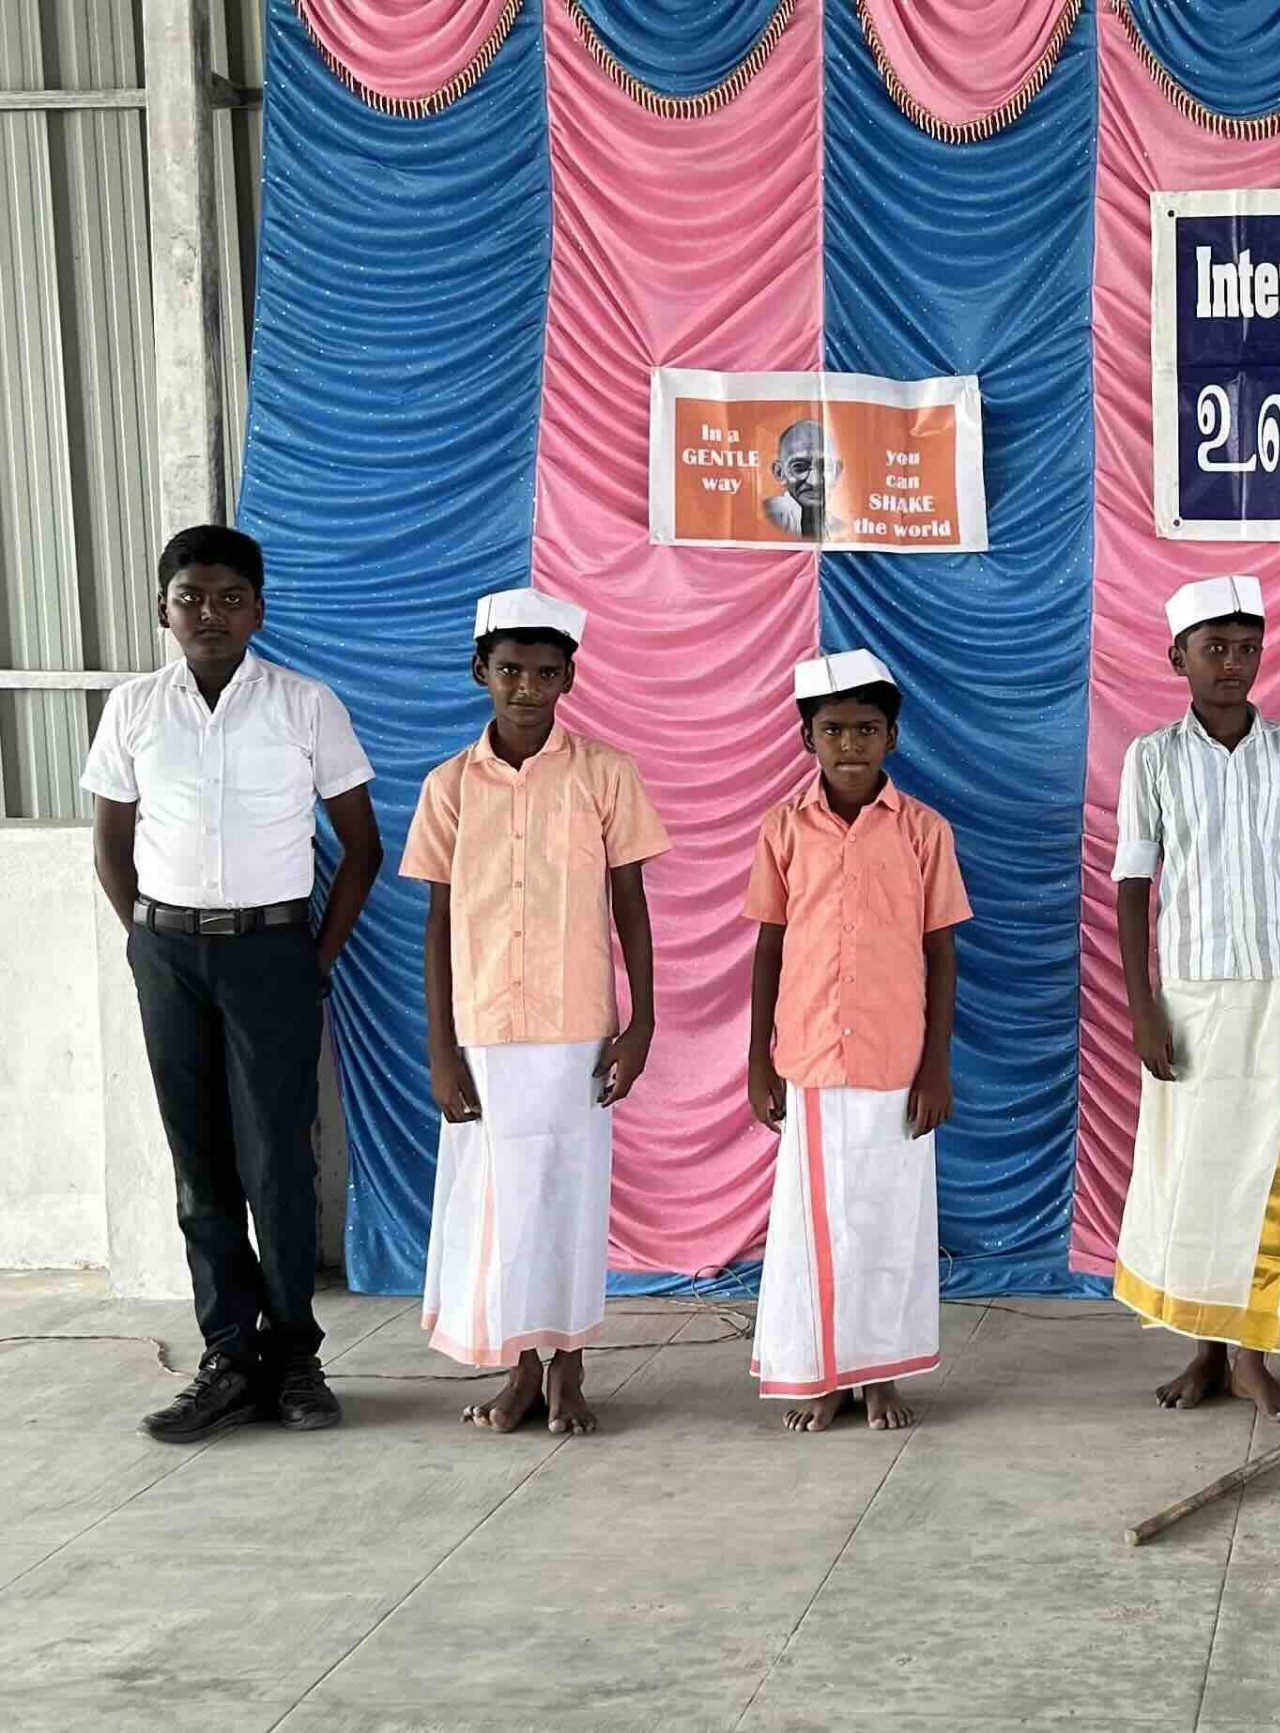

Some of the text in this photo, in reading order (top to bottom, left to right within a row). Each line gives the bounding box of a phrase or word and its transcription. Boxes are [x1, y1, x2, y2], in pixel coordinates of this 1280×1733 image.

[701, 424, 740, 443] In a
[682, 448, 760, 468] GENTLE
[885, 450, 920, 466] you
[701, 478, 742, 494] way
[885, 474, 920, 490] can
[868, 493, 935, 513] SHAKE
[854, 518, 951, 538] the world
